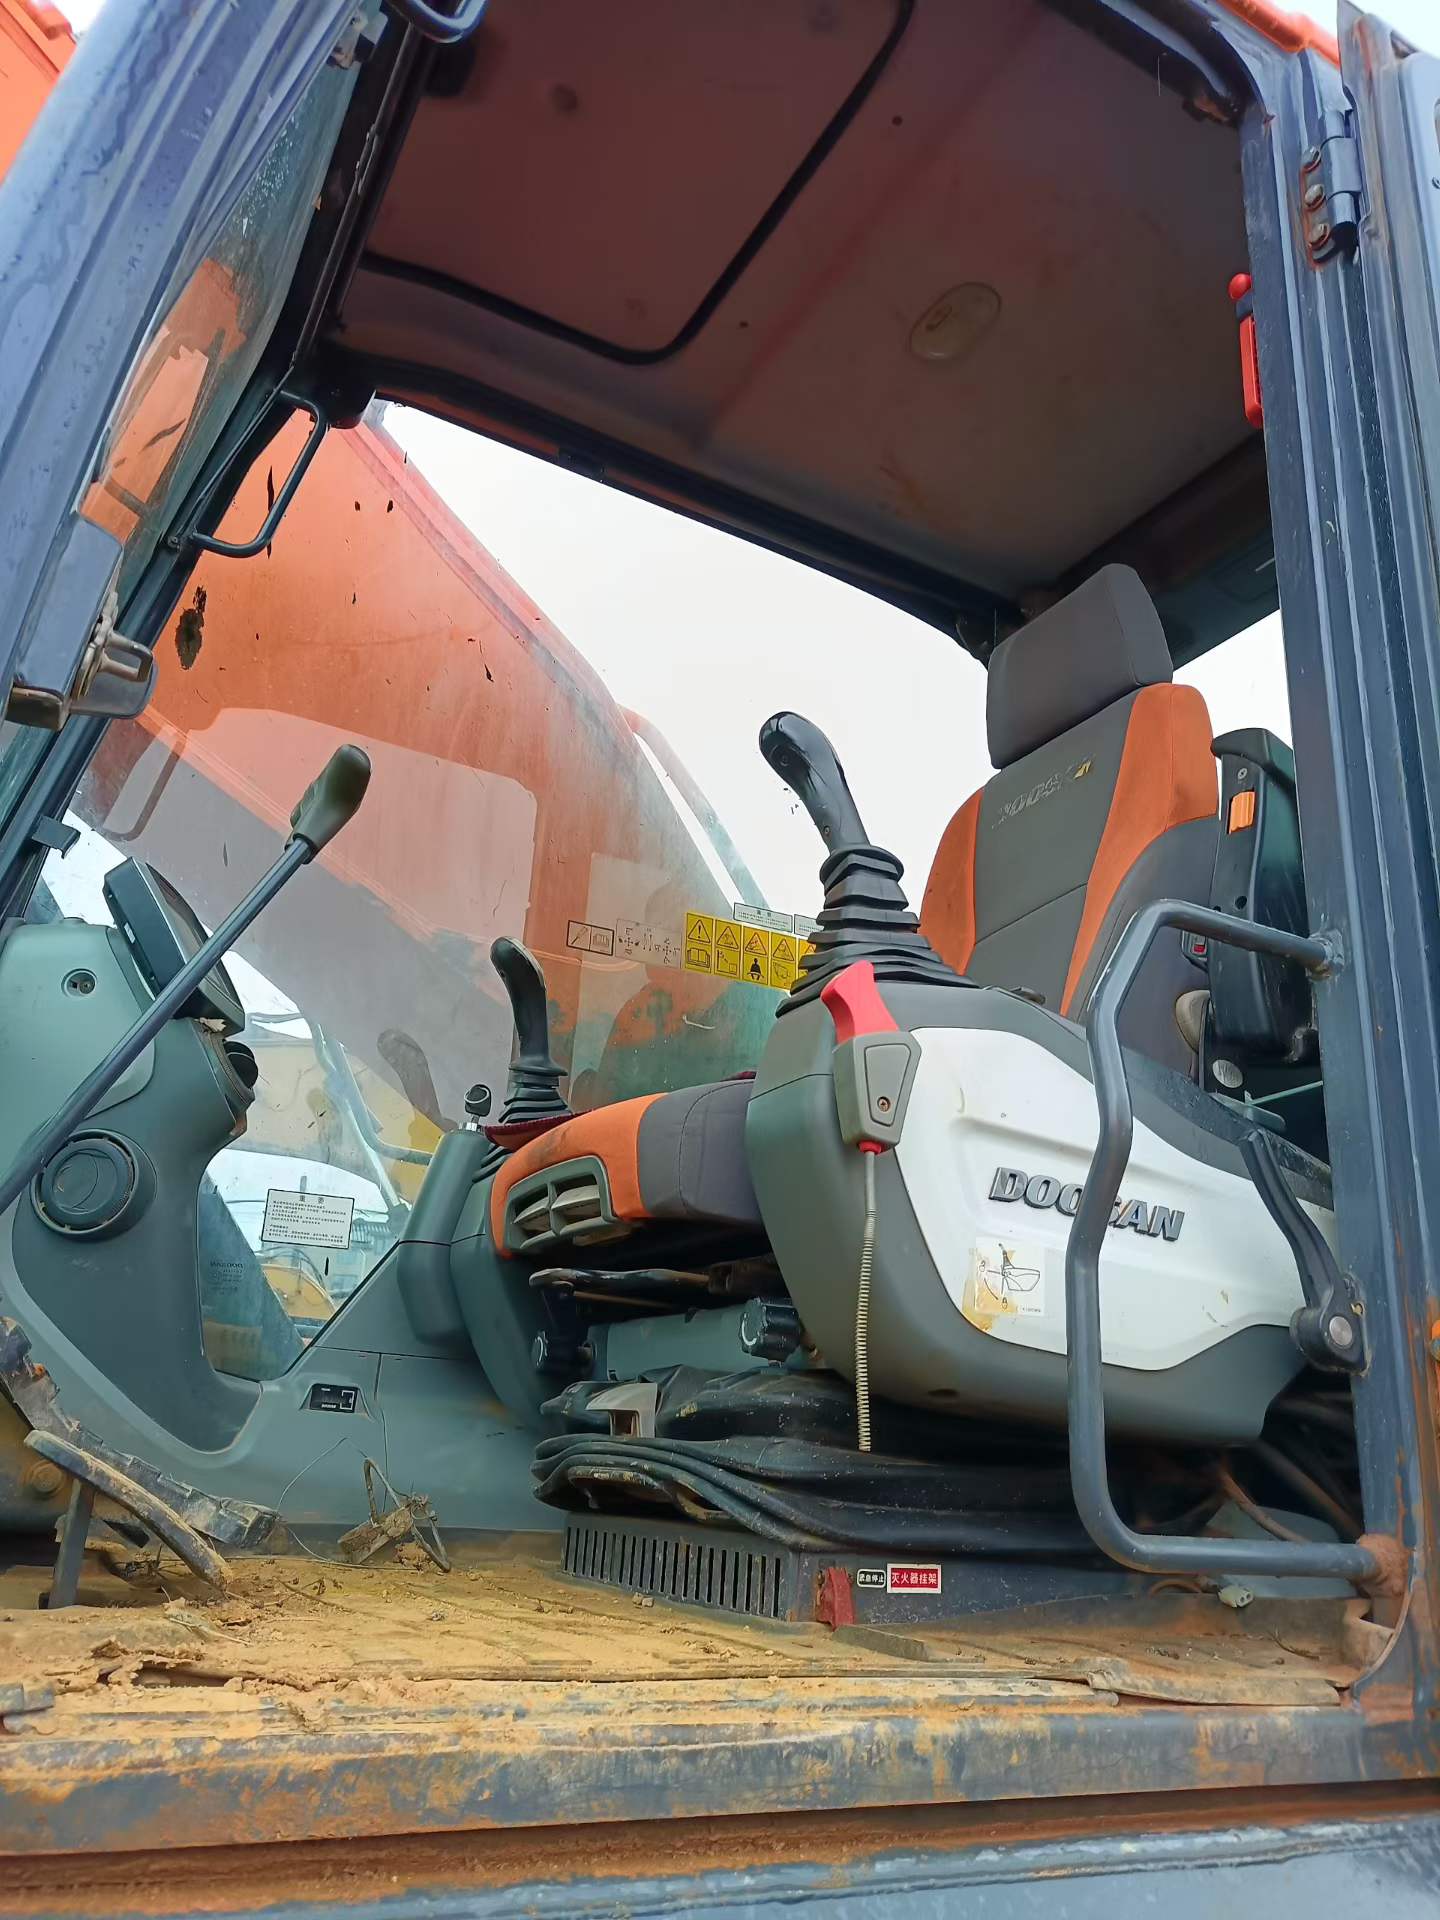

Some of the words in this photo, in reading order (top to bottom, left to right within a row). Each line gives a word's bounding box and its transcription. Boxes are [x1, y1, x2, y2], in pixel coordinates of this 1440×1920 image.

[891, 1572, 937, 1585] 灭火器挂架
